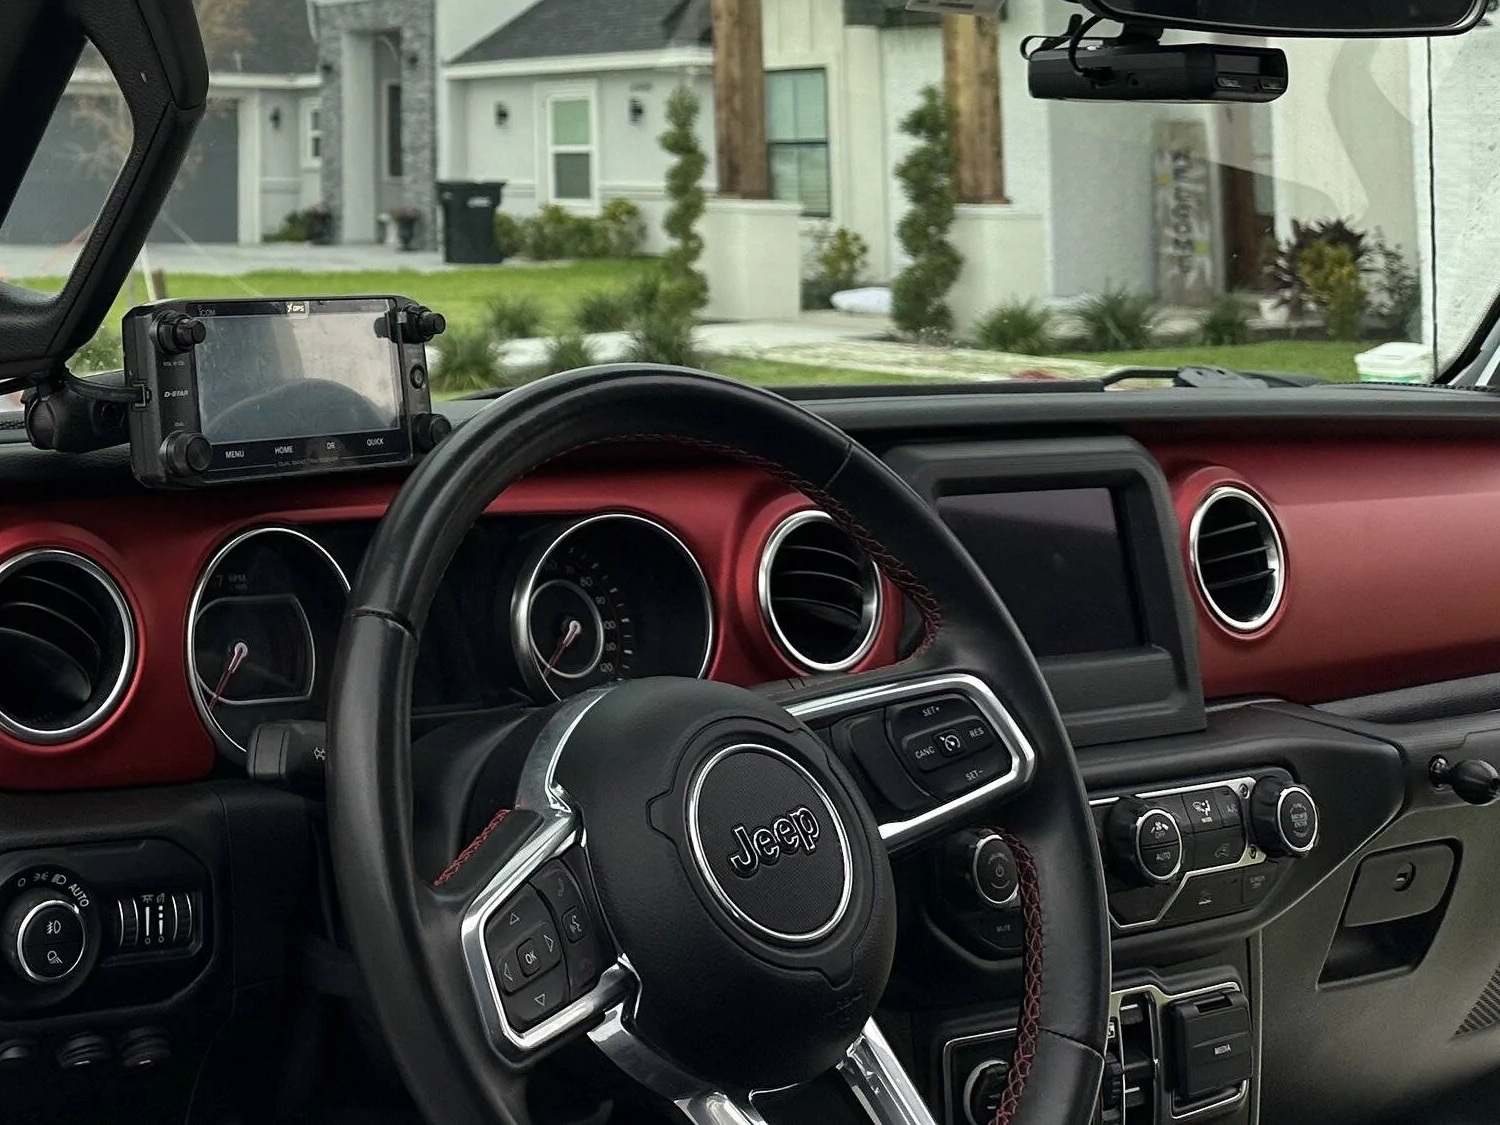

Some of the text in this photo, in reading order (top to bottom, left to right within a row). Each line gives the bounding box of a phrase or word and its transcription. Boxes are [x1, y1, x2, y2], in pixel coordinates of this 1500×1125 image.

[163, 389, 189, 398] D-STAR
[366, 437, 385, 447] QUICK
[225, 450, 245, 459] MENU
[274, 445, 294, 454] HOME
[968, 726, 985, 739] RES
[914, 745, 935, 759] CANC
[729, 806, 819, 876] Jeep
[68, 883, 89, 907] AUTO
[525, 950, 538, 965] OK
[1214, 1043, 1232, 1056] MEDIA
